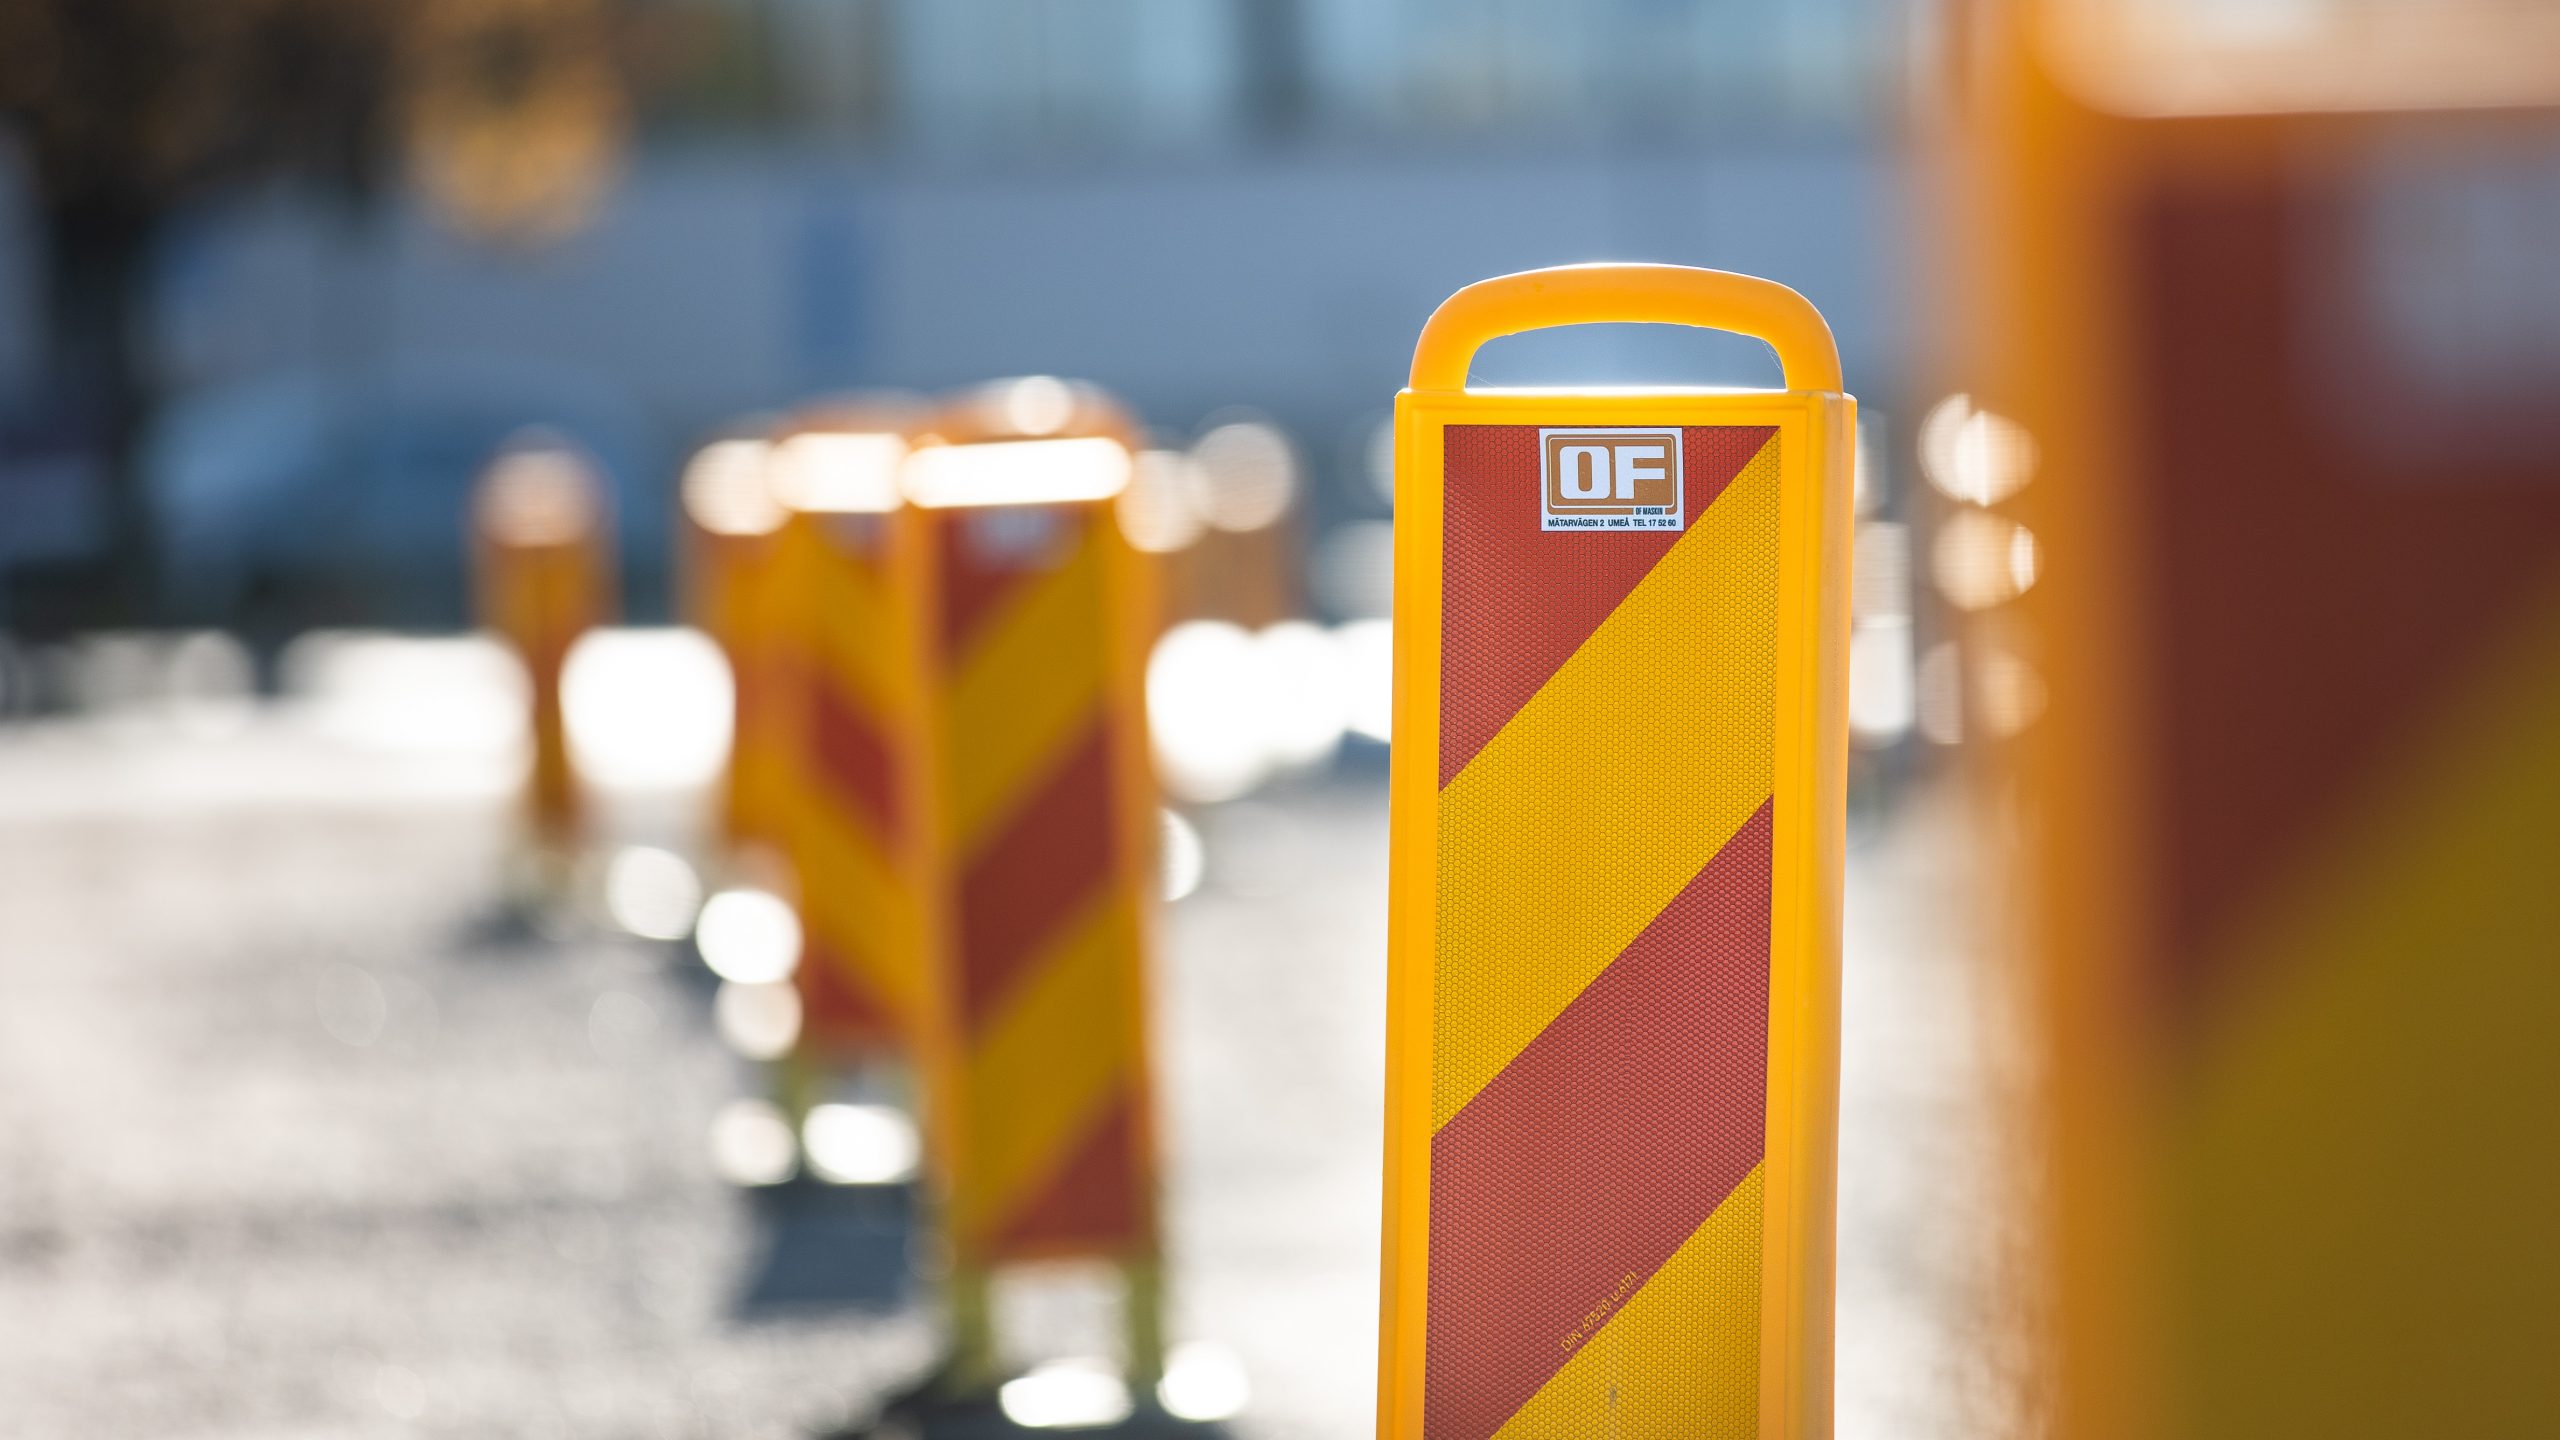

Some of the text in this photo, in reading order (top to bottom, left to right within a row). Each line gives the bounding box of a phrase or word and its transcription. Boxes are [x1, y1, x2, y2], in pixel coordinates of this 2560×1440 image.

[1560, 445, 1666, 500] OF
[1548, 517, 1677, 527] MÄTARVÄGEN 2 UMEÅ TEL 17 52 60
[1636, 507, 1664, 515] OF MASKIN
[1561, 1329, 1583, 1352] DIN
[1581, 1299, 1611, 1332] 67520
